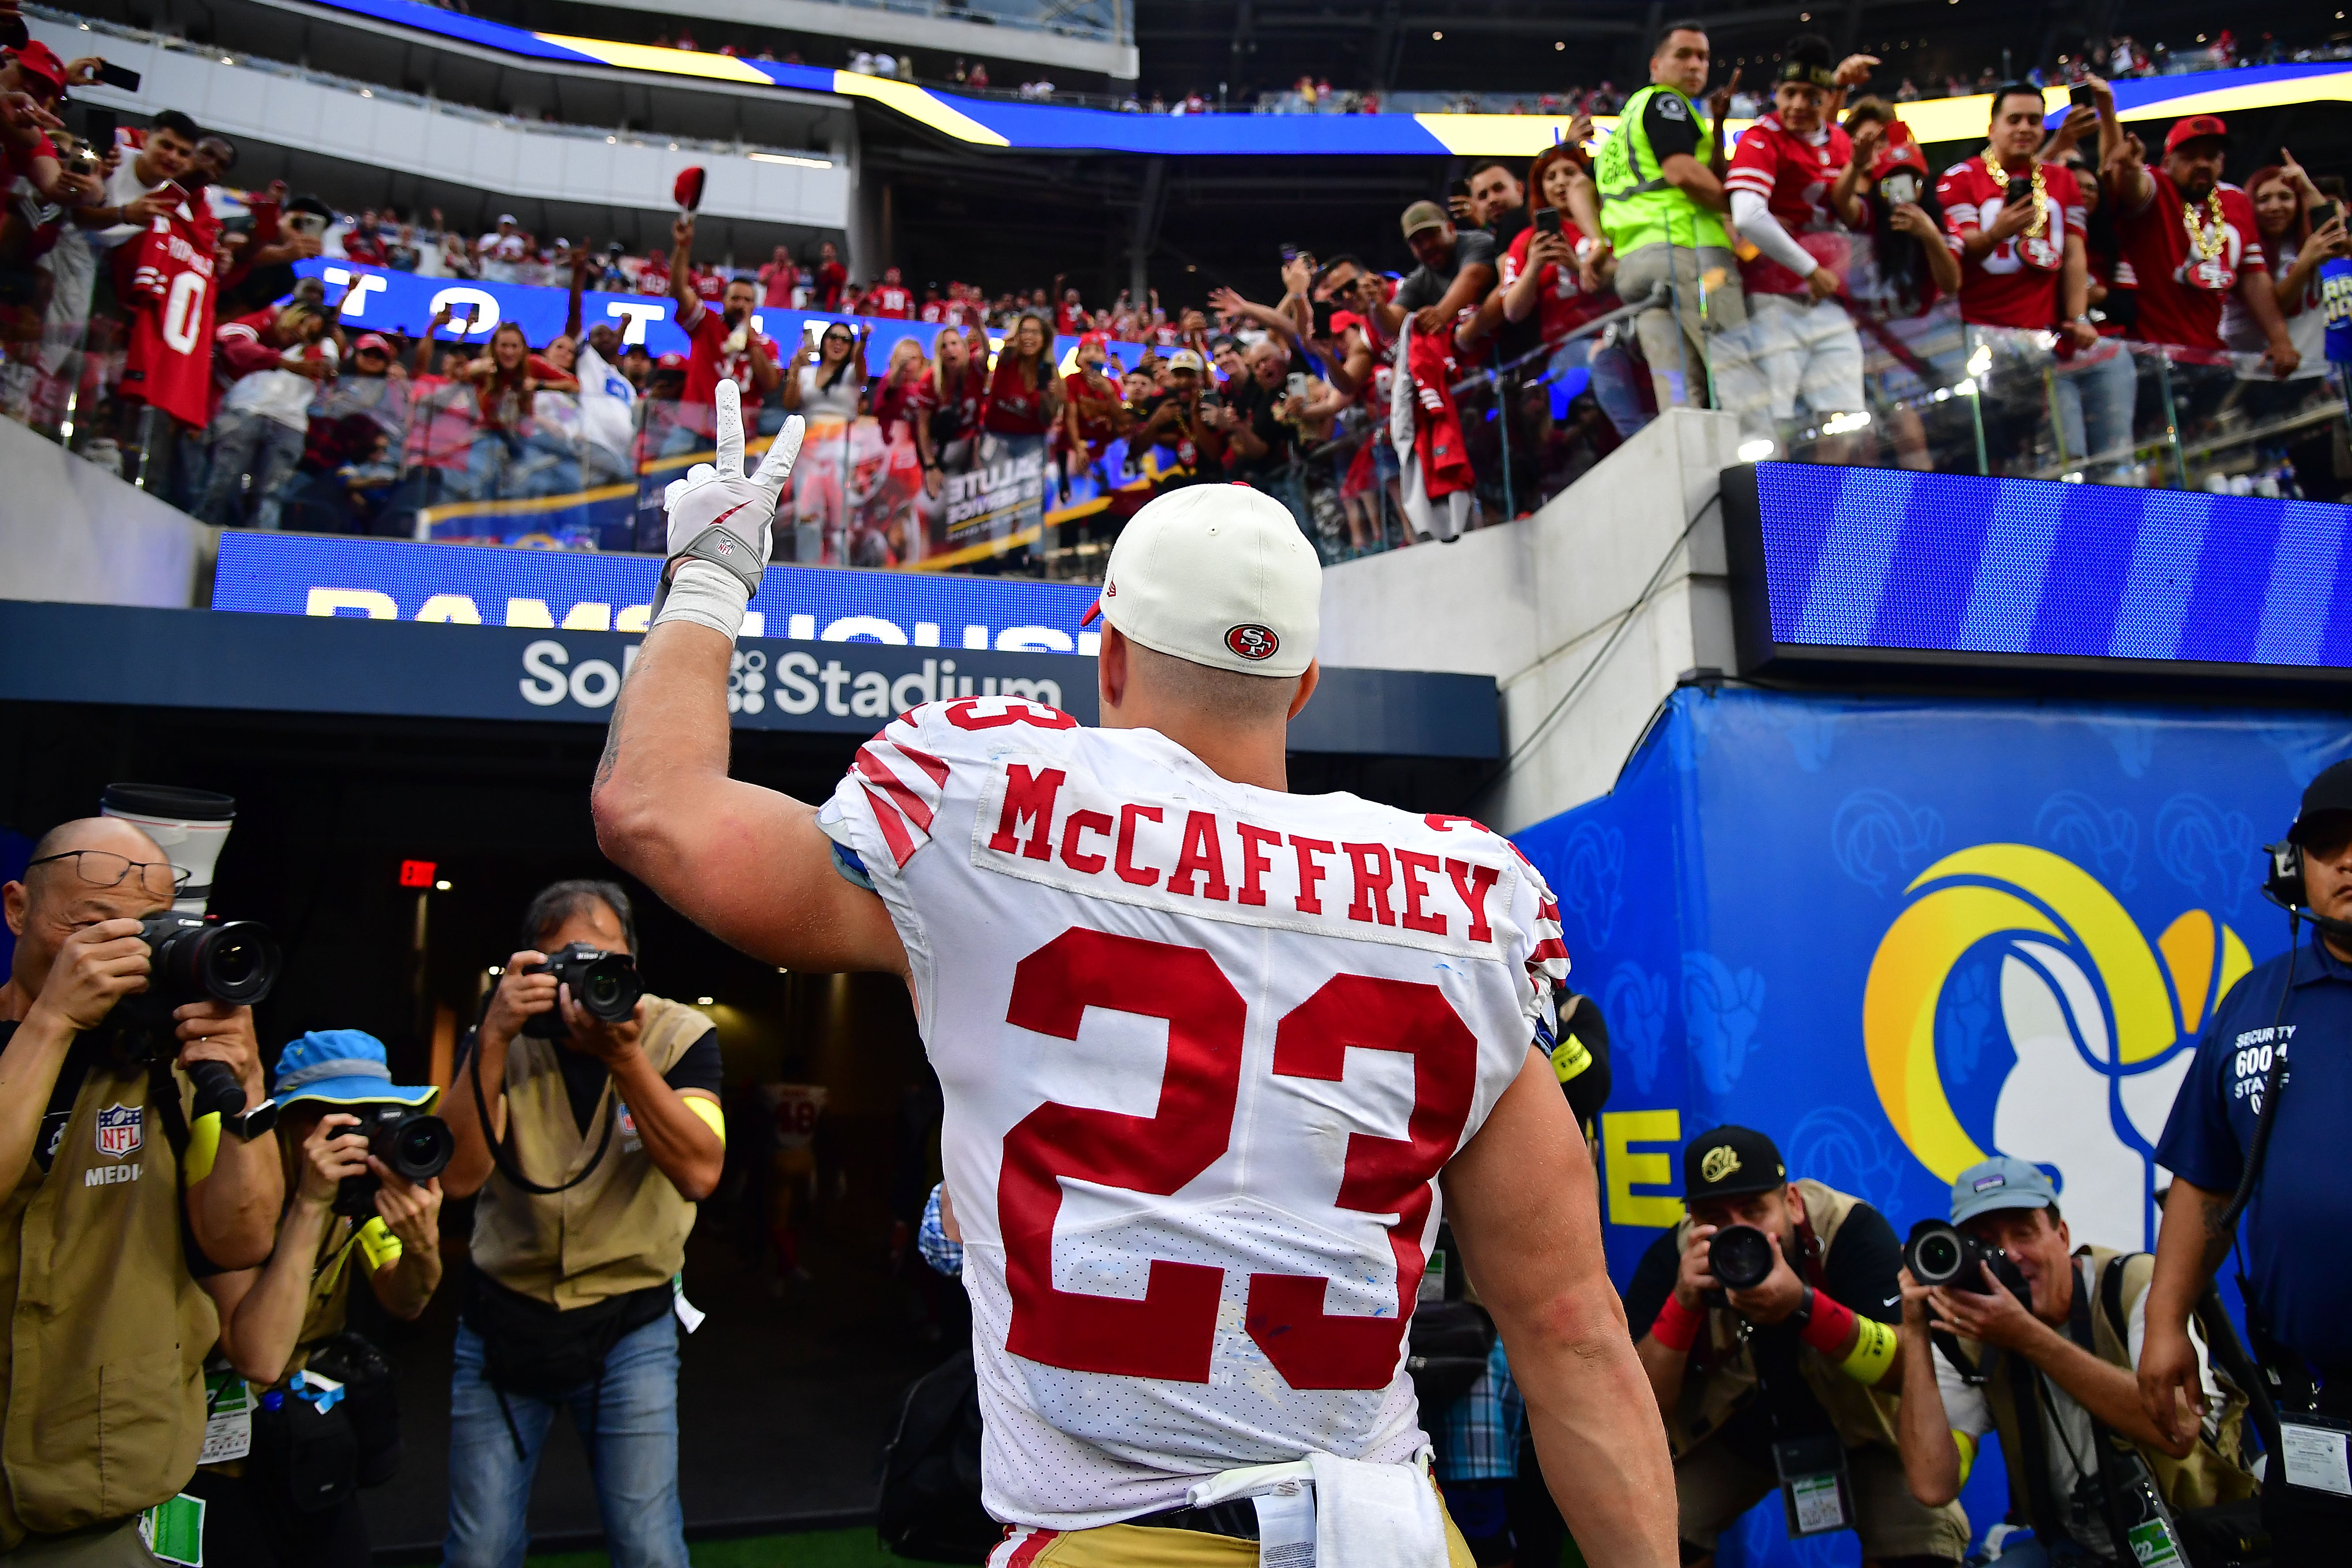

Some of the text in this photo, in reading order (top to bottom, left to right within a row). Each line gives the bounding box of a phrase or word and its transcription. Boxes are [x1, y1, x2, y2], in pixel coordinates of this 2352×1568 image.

[519, 639, 643, 708] So
[989, 763, 1499, 943] McCAFFREY
[2235, 1025, 2297, 1049] SECURTY
[2234, 1072, 2290, 1099] STAF
[102, 1126, 139, 1151] NFL
[997, 925, 1478, 1390] 23
[84, 1163, 144, 1188] MEDI
